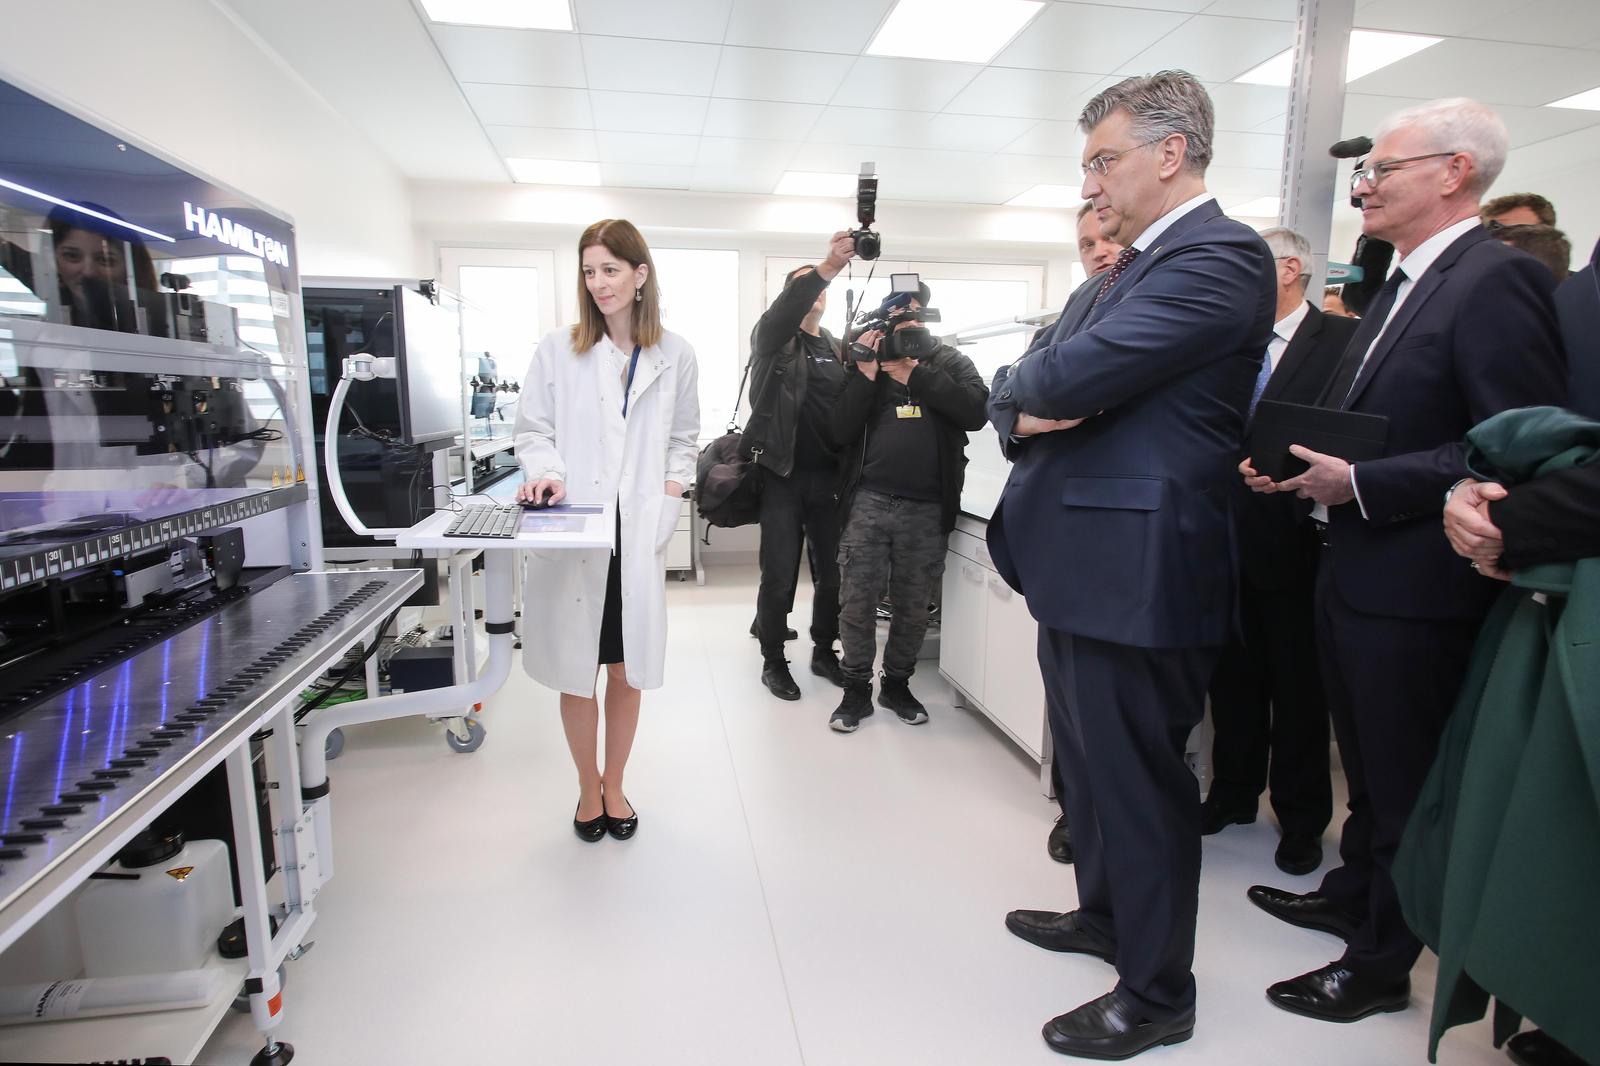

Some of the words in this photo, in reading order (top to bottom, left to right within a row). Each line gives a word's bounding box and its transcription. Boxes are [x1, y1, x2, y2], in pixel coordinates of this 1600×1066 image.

[183, 201, 289, 268] HAMILTON
[48, 550, 59, 561] 30
[111, 534, 120, 544] 35
